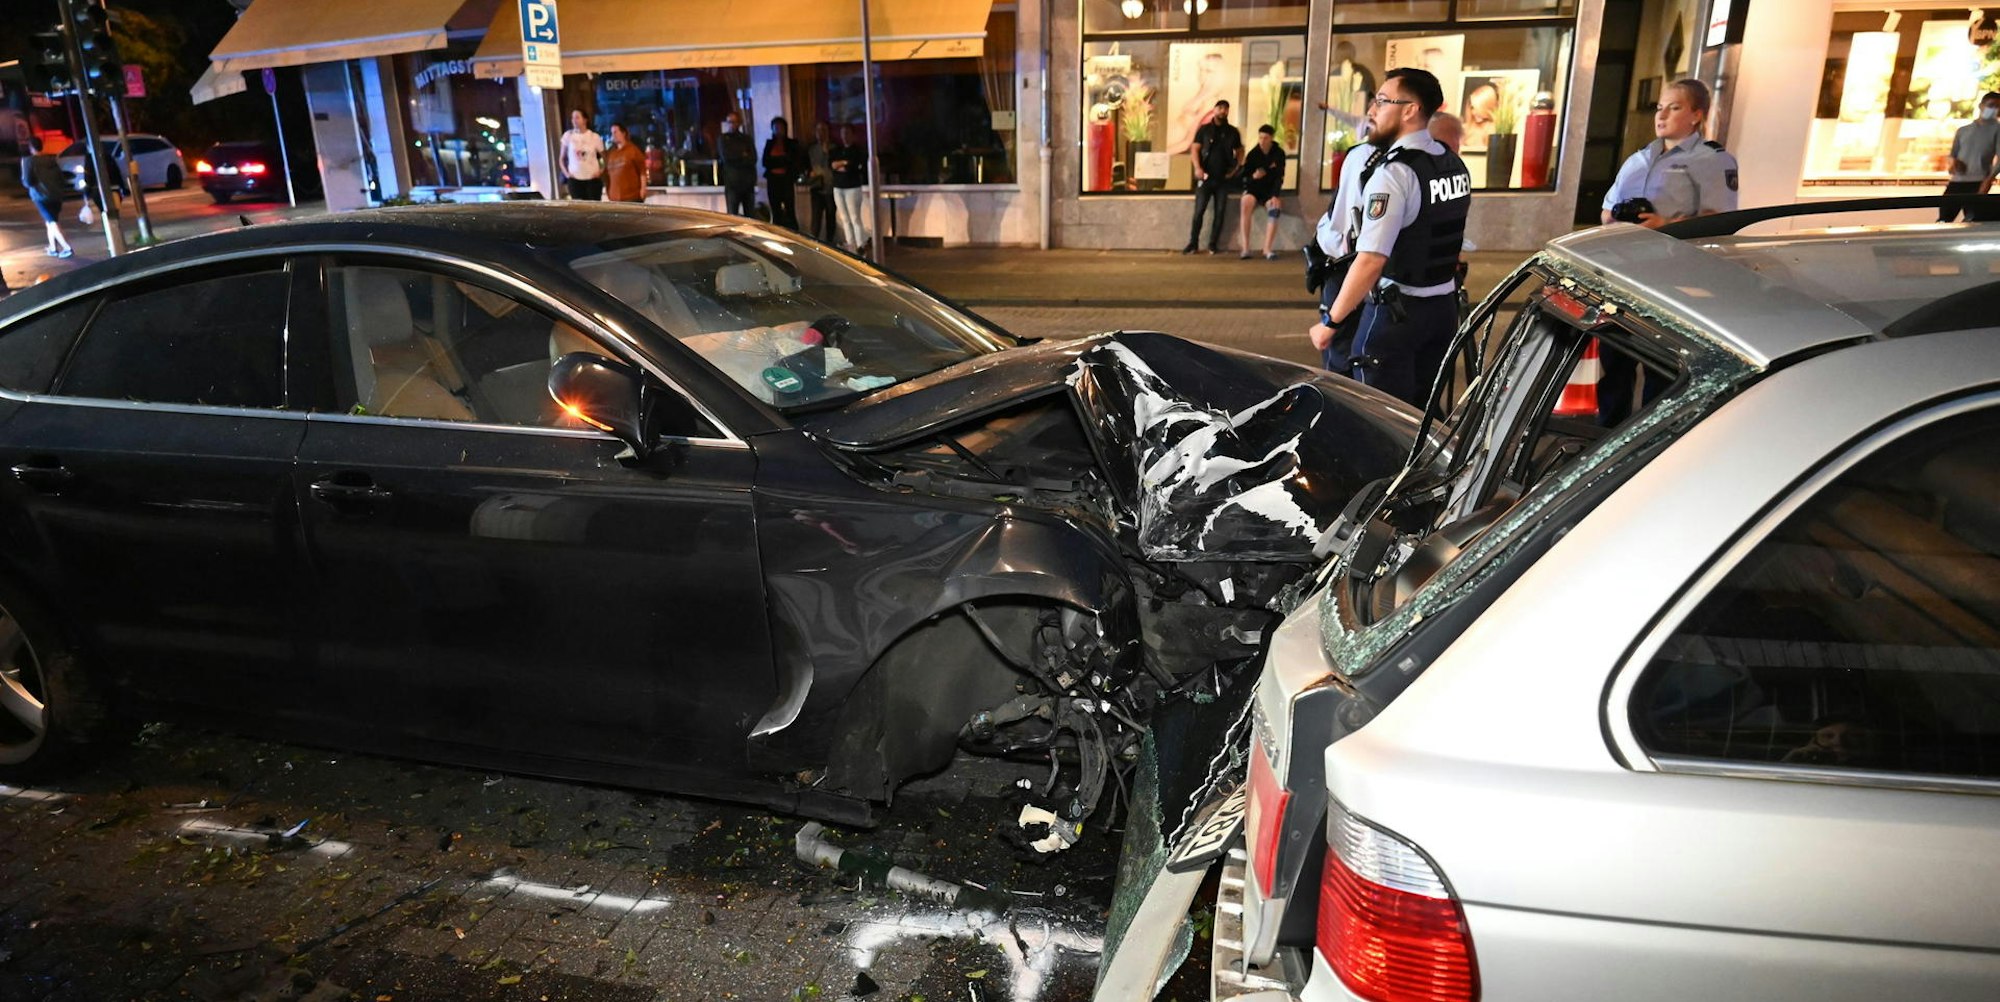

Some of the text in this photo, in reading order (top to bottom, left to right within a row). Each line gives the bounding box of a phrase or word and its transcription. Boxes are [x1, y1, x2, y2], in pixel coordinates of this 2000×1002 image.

[528, 3, 549, 38] P
[414, 59, 504, 89] MITTAGST
[605, 79, 629, 92] DEN
[1429, 173, 1471, 205] POLIZEI
